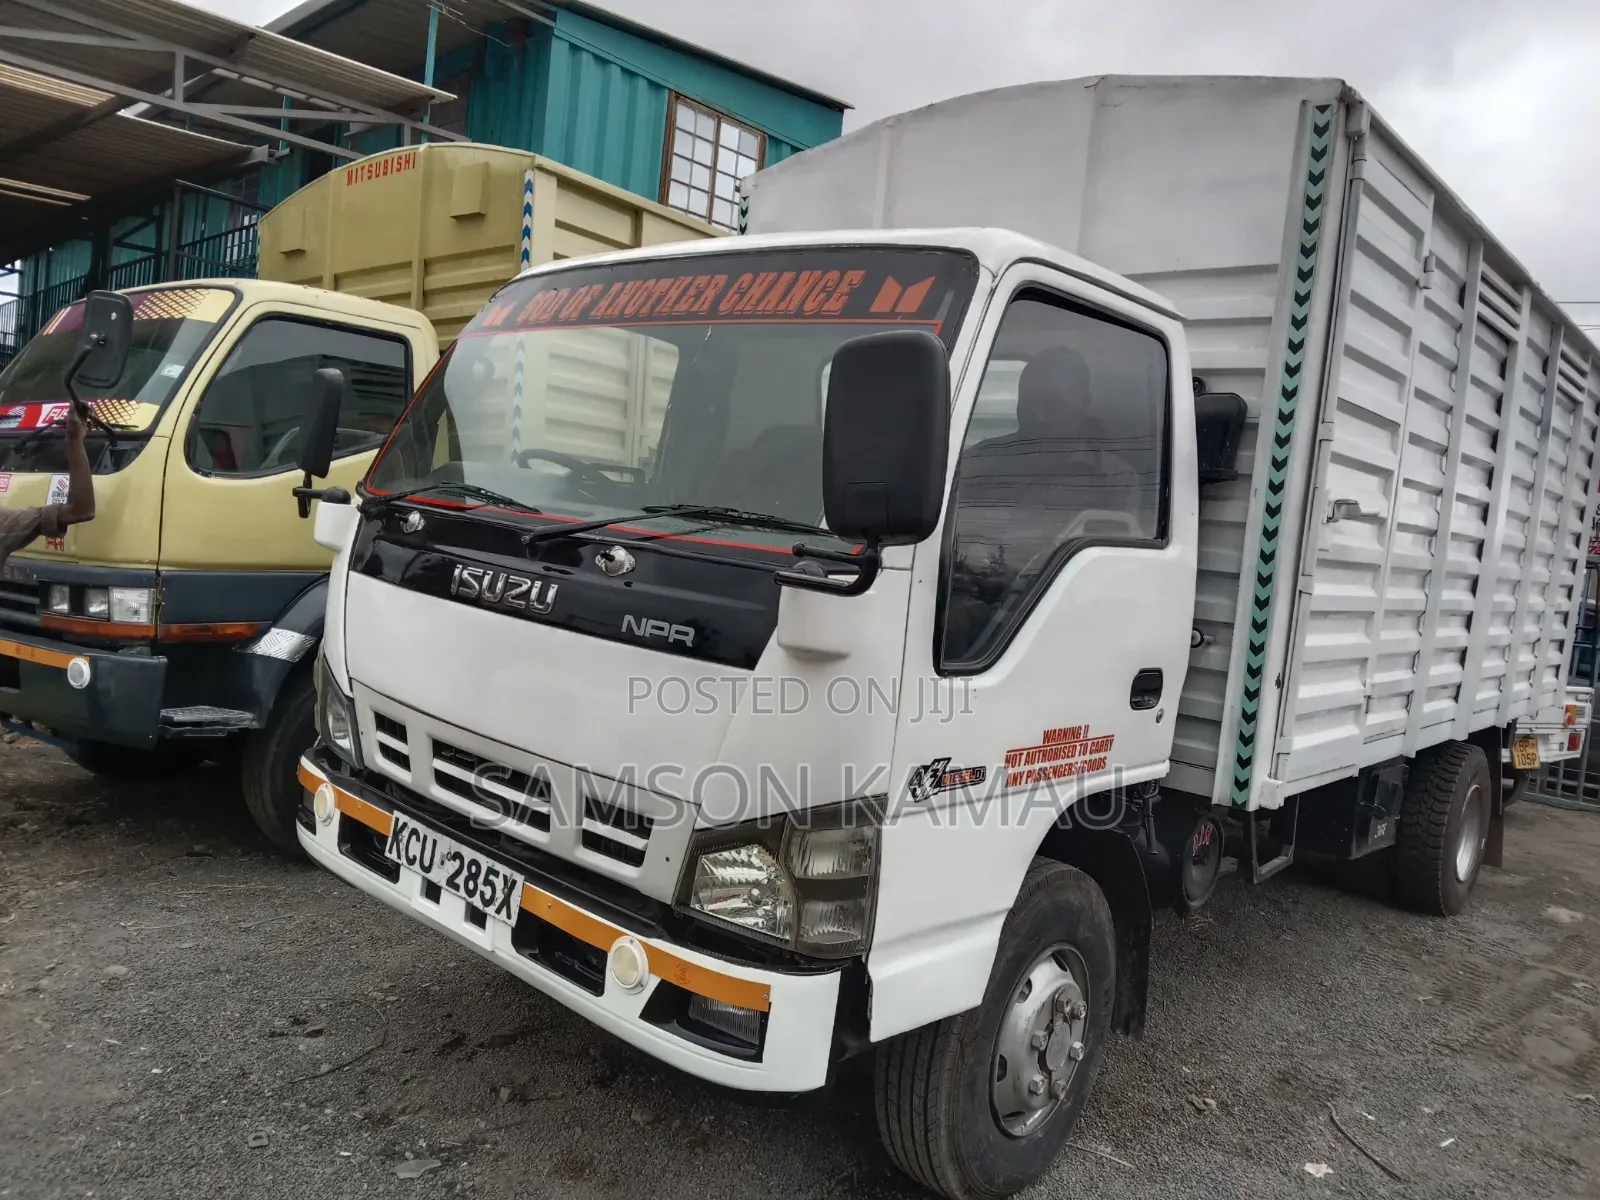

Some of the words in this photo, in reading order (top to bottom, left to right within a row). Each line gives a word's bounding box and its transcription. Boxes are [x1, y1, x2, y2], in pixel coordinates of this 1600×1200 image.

[346, 151, 417, 187] MITSUBISHI
[558, 283, 604, 321] OF
[588, 274, 728, 319] ANOTHER
[718, 270, 867, 315] CHANGE
[45, 408, 70, 421] FUS
[450, 564, 559, 614] ISUZU
[621, 614, 695, 647] NPR
[1043, 726, 1082, 744] WARNING
[1083, 724, 1090, 738] !!
[1514, 739, 1530, 753] KBP
[1004, 752, 1024, 769] NOT
[1024, 745, 1077, 766] AUTHORISED
[1078, 742, 1089, 757] TO
[1089, 738, 1114, 755] CARRY
[1517, 753, 1537, 766] 105P
[1005, 770, 1026, 788] ANY
[387, 816, 438, 874] KCU
[445, 851, 518, 921] 285X
